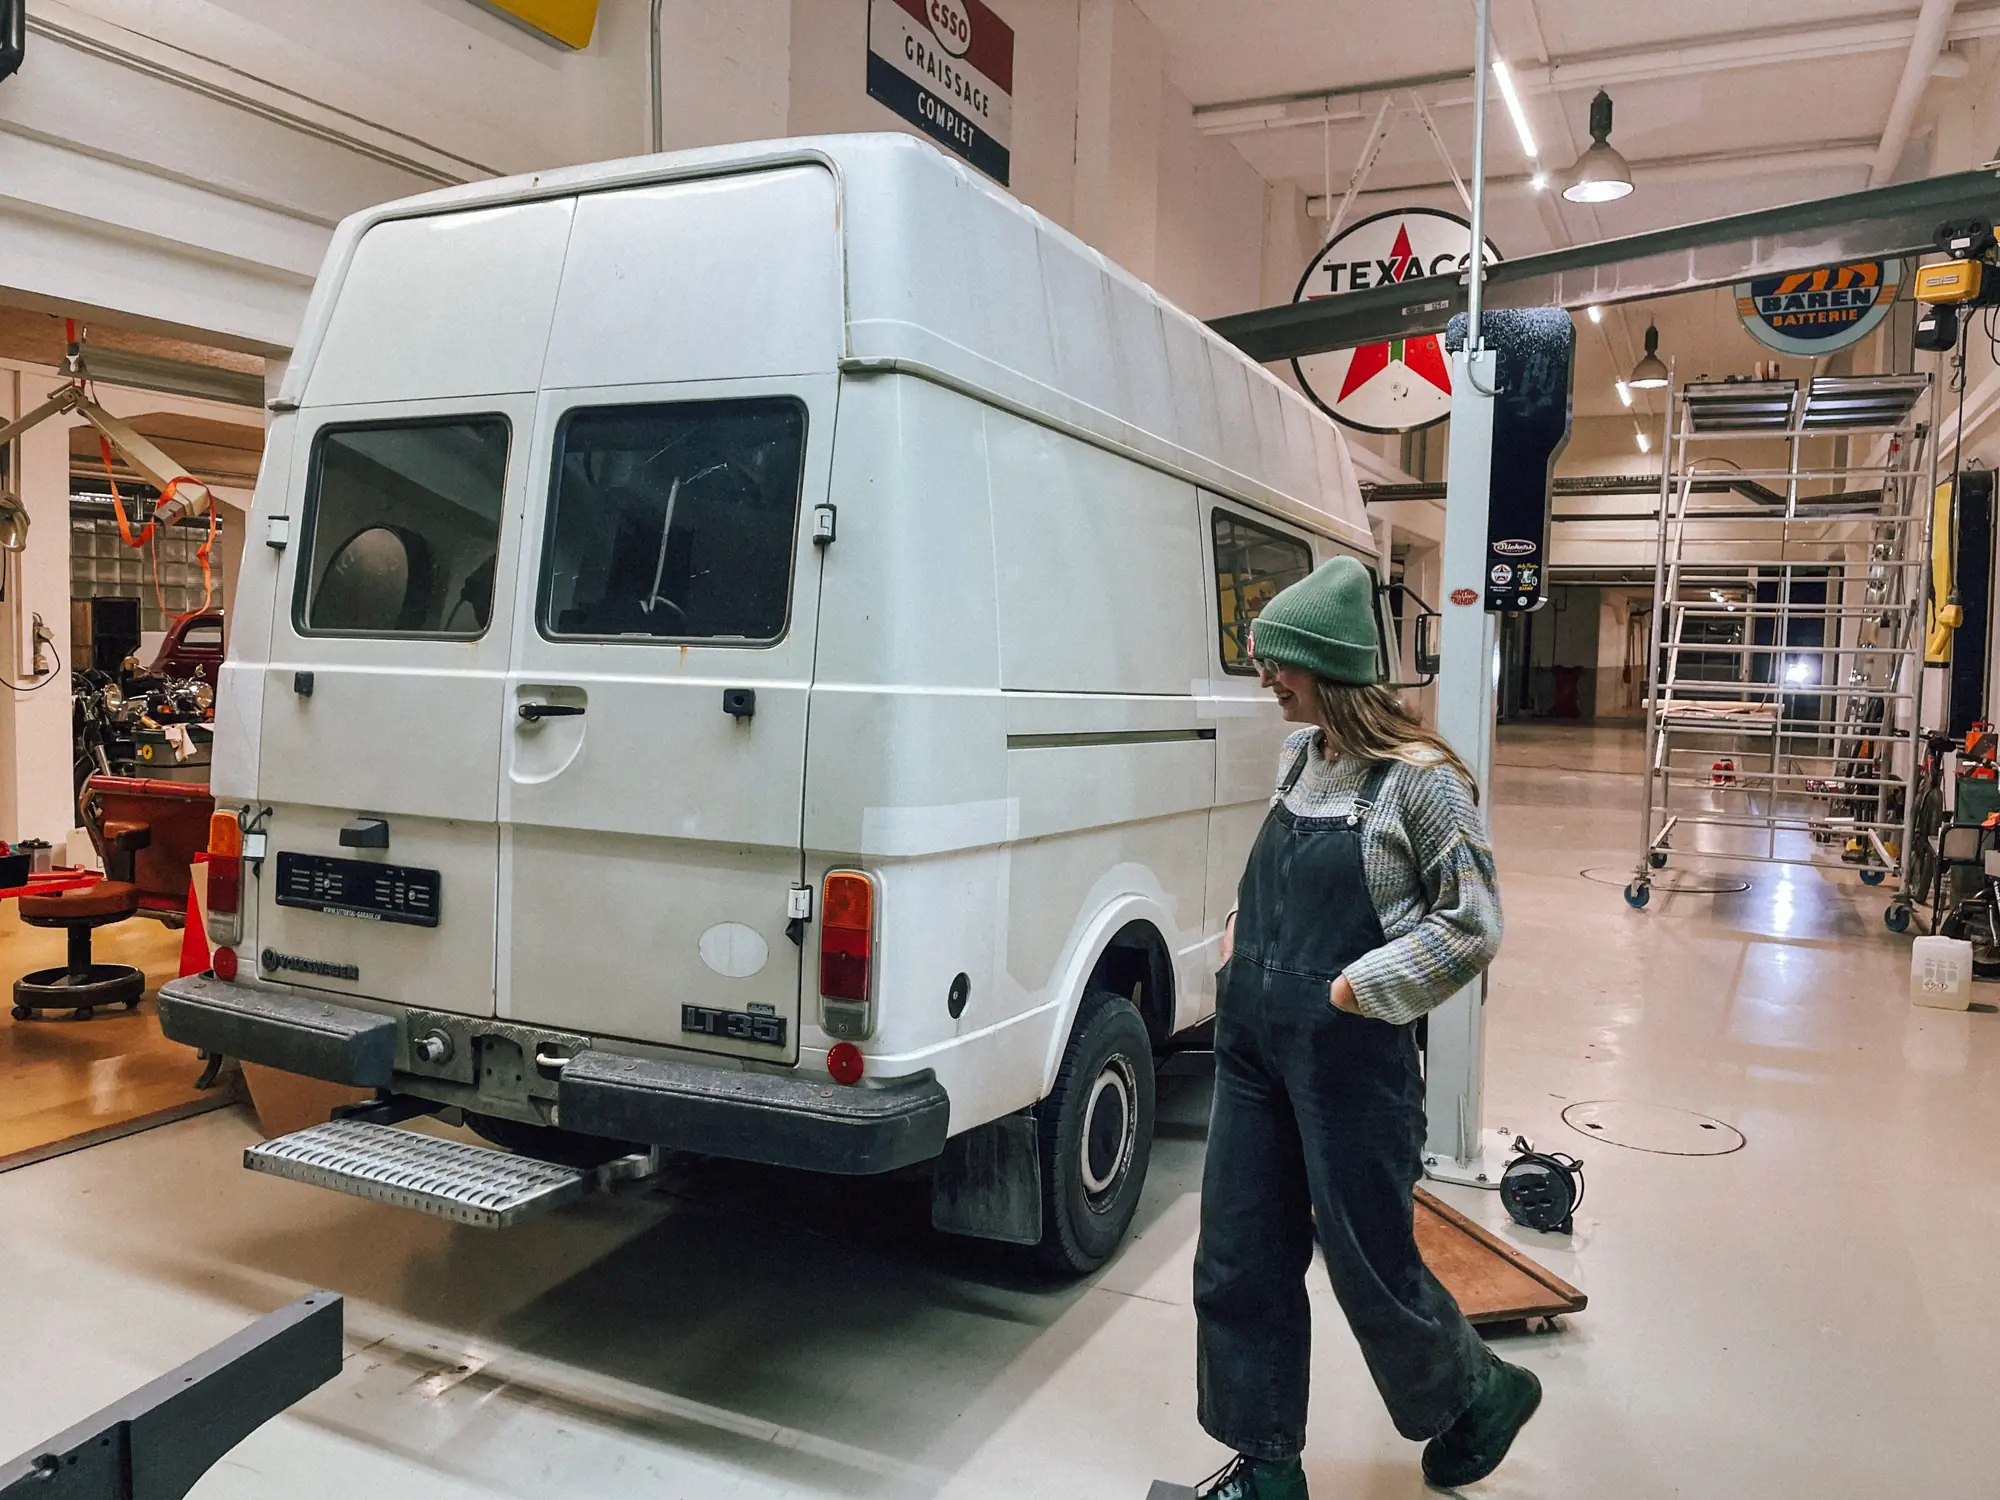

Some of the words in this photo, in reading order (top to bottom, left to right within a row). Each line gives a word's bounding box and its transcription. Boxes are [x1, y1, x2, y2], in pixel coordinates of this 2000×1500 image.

[905, 35, 989, 118] GRAISSAGE
[917, 91, 975, 147] COMPLET
[1761, 288, 1872, 313] BÄREN
[1772, 308, 1858, 327] BATTERIE
[686, 1007, 722, 1033] LT
[727, 1012, 779, 1041] 35
